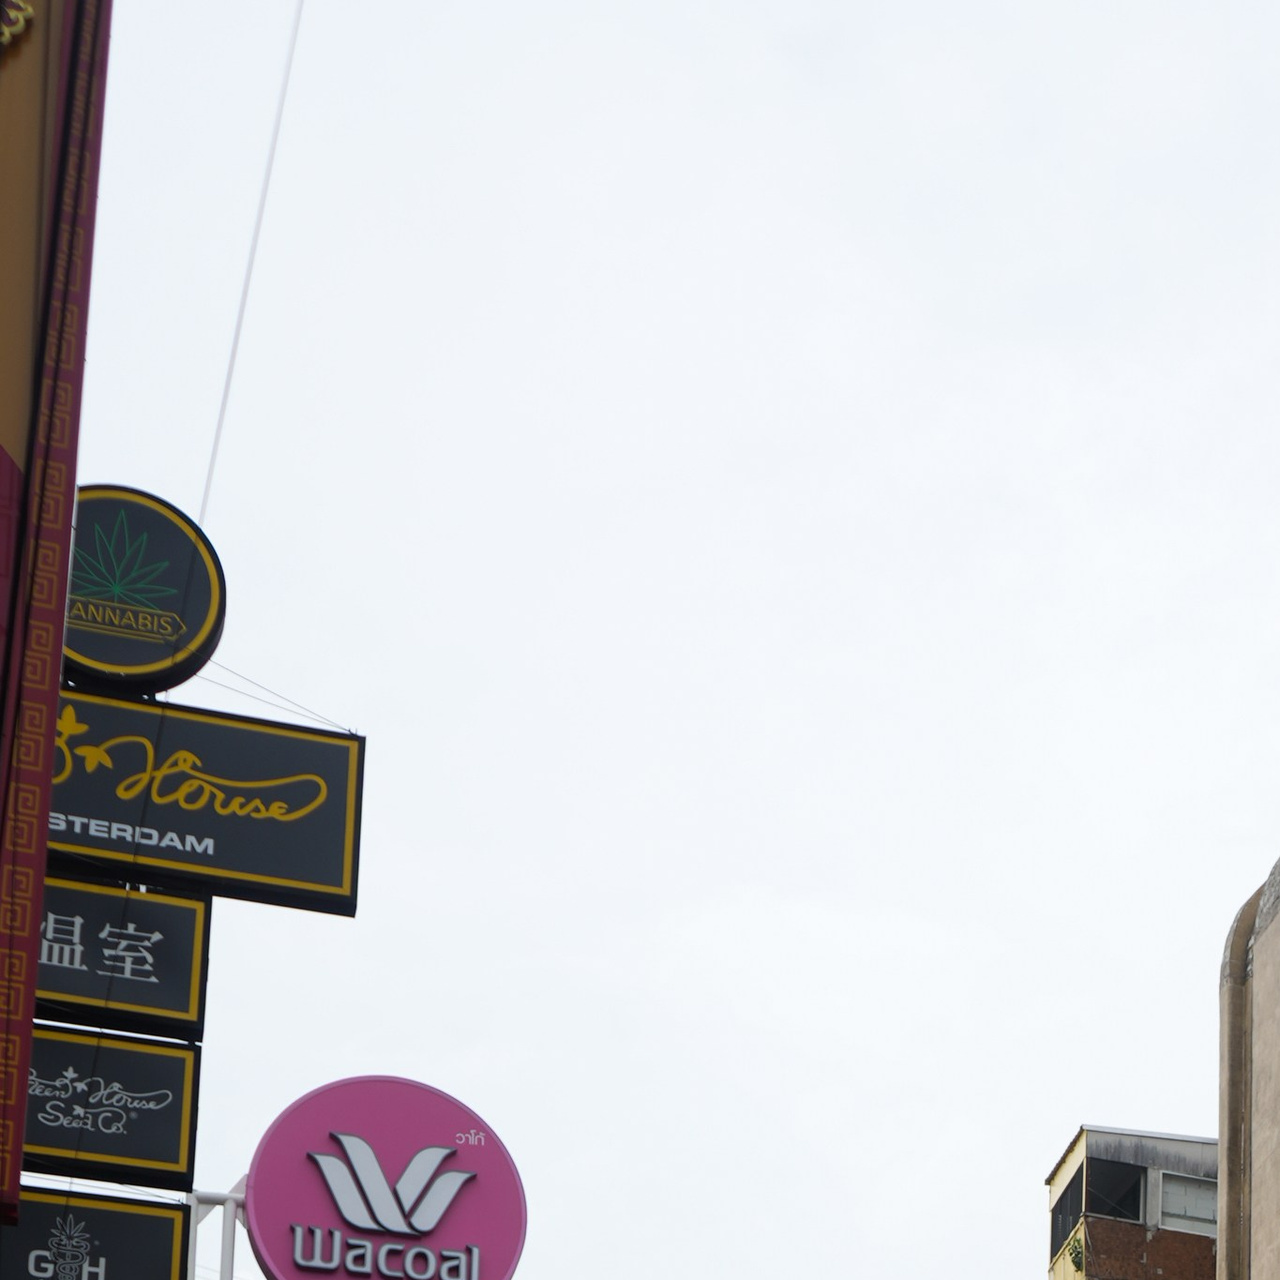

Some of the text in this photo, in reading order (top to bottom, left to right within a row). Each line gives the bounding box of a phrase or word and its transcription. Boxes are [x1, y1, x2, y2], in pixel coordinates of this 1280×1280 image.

[68, 600, 174, 635] ANNABIS
[39, 911, 165, 986] 温室
[83, 1077, 173, 1110] House
[38, 1101, 95, 1132] Seed
[455, 1130, 486, 1147] วาโก้
